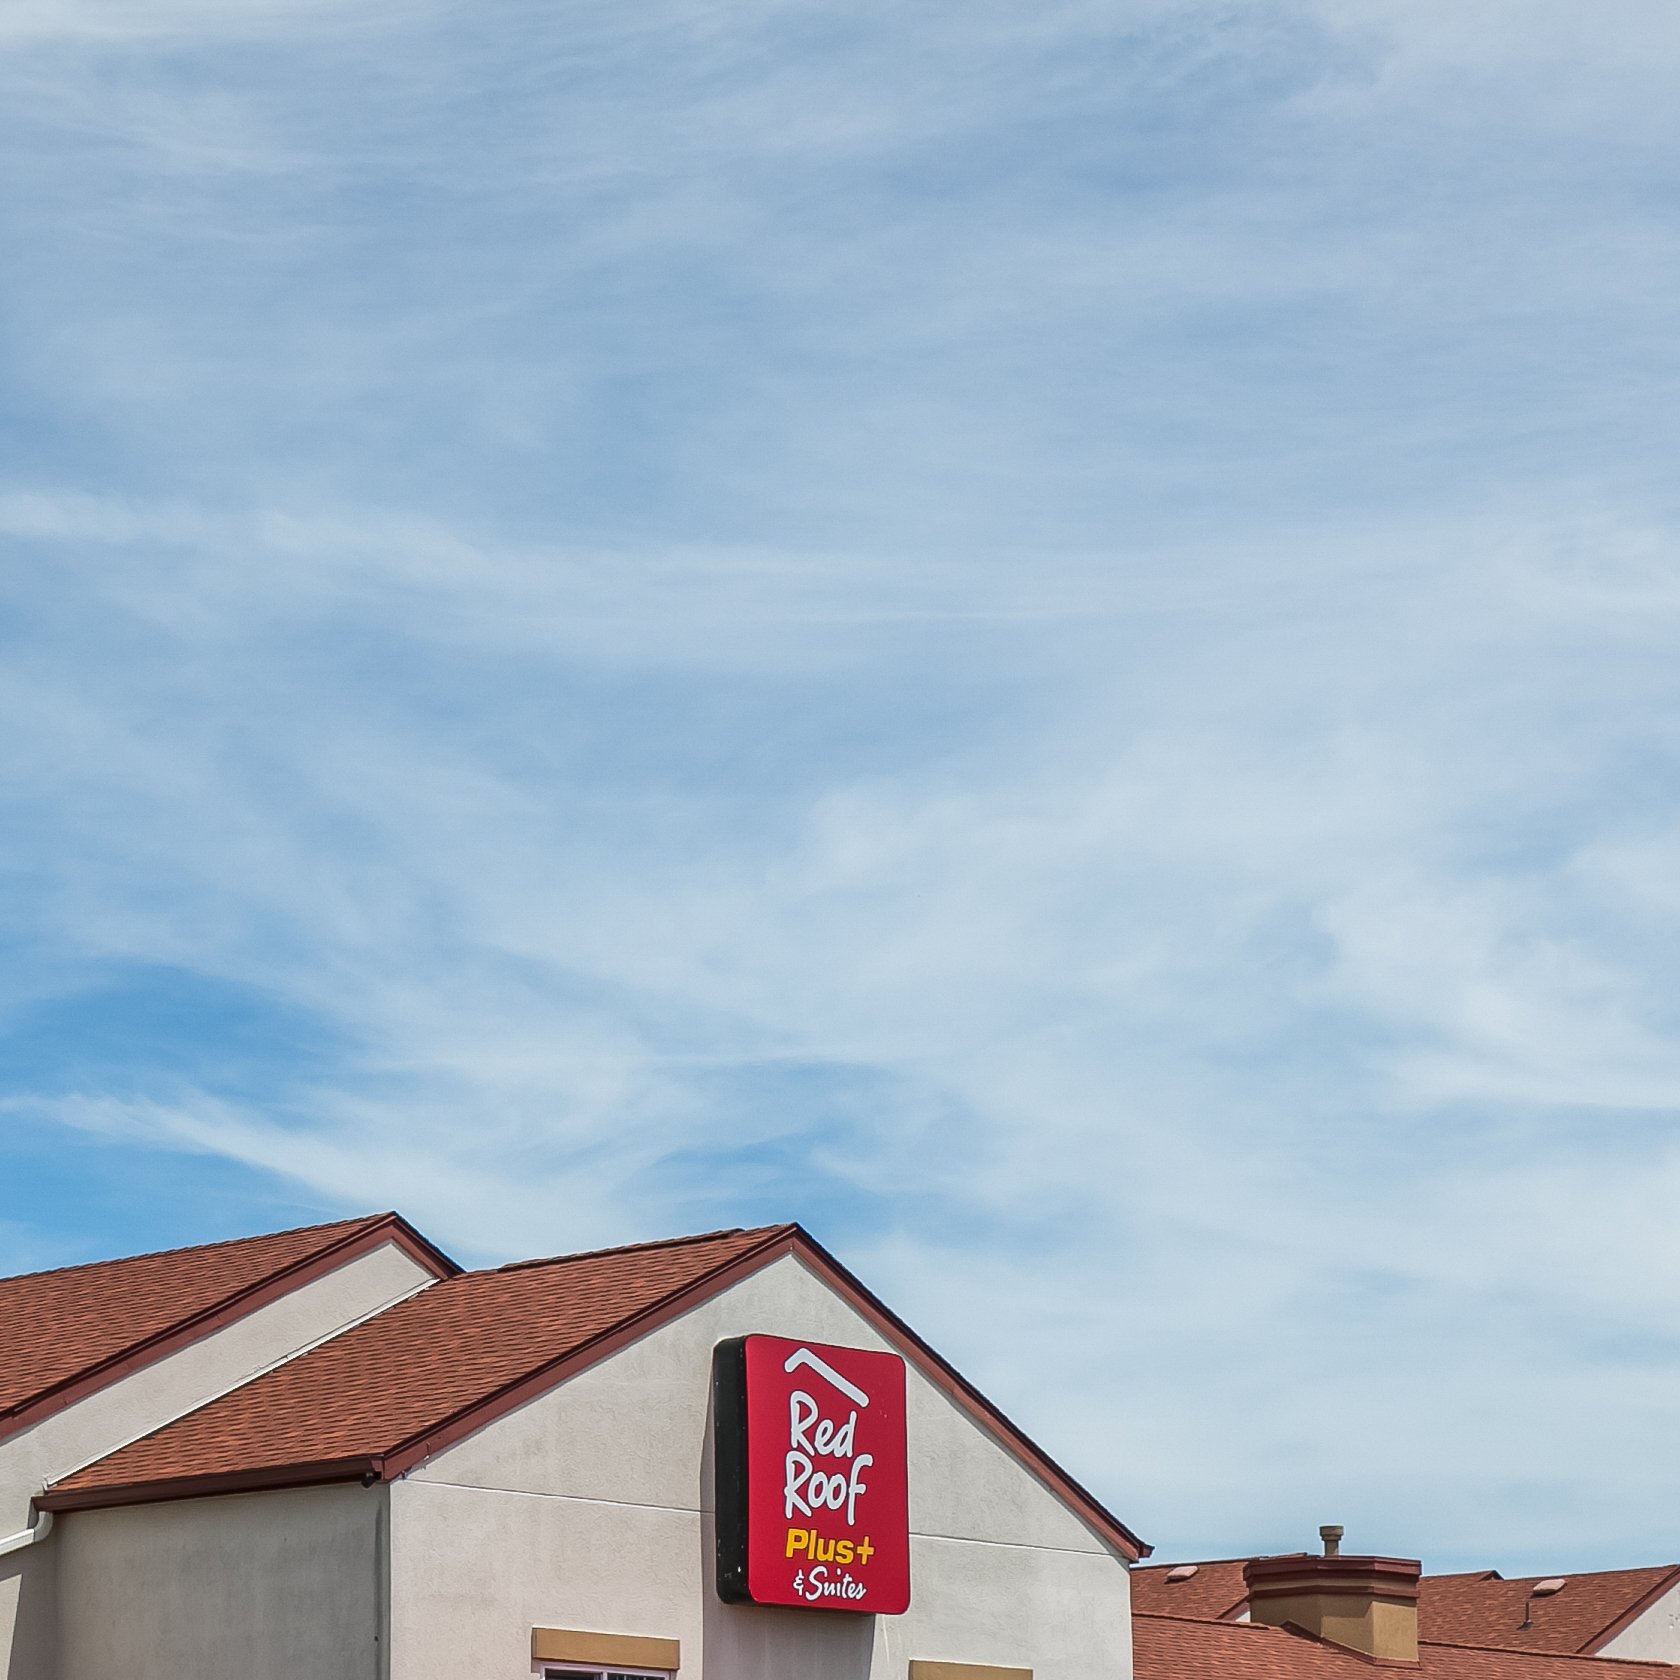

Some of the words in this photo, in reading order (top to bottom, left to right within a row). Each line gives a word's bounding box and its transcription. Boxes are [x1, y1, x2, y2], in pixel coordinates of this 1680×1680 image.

[790, 1390, 857, 1458] Red
[783, 1450, 873, 1526] Roof
[785, 1528, 874, 1566] Plus+
[792, 1569, 805, 1596] &
[805, 1566, 867, 1601] Suites
